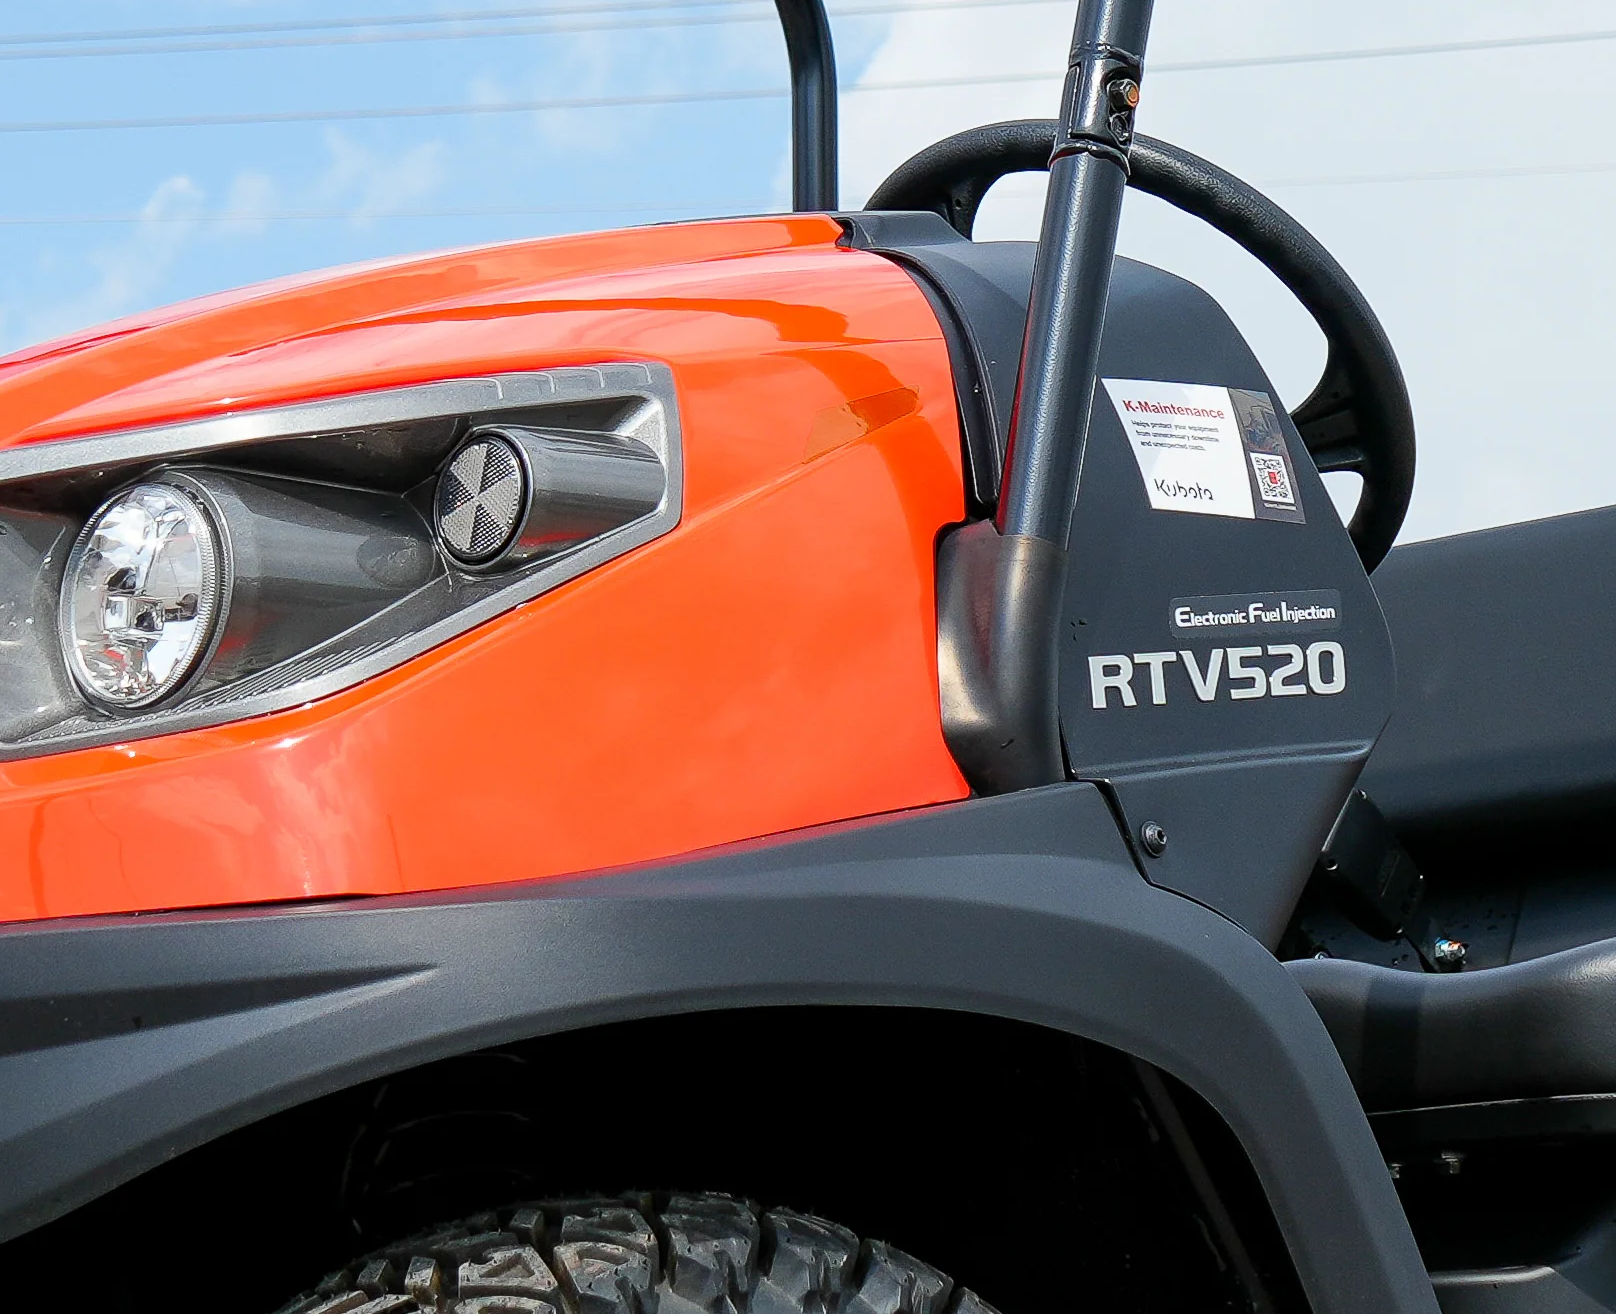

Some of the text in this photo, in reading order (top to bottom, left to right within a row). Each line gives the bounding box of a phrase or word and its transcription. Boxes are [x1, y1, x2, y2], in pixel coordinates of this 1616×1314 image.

[1153, 478, 1214, 500] Kubota
[1175, 601, 1336, 627] Electronic Fuel Injection
[1088, 641, 1346, 709] RTV520
